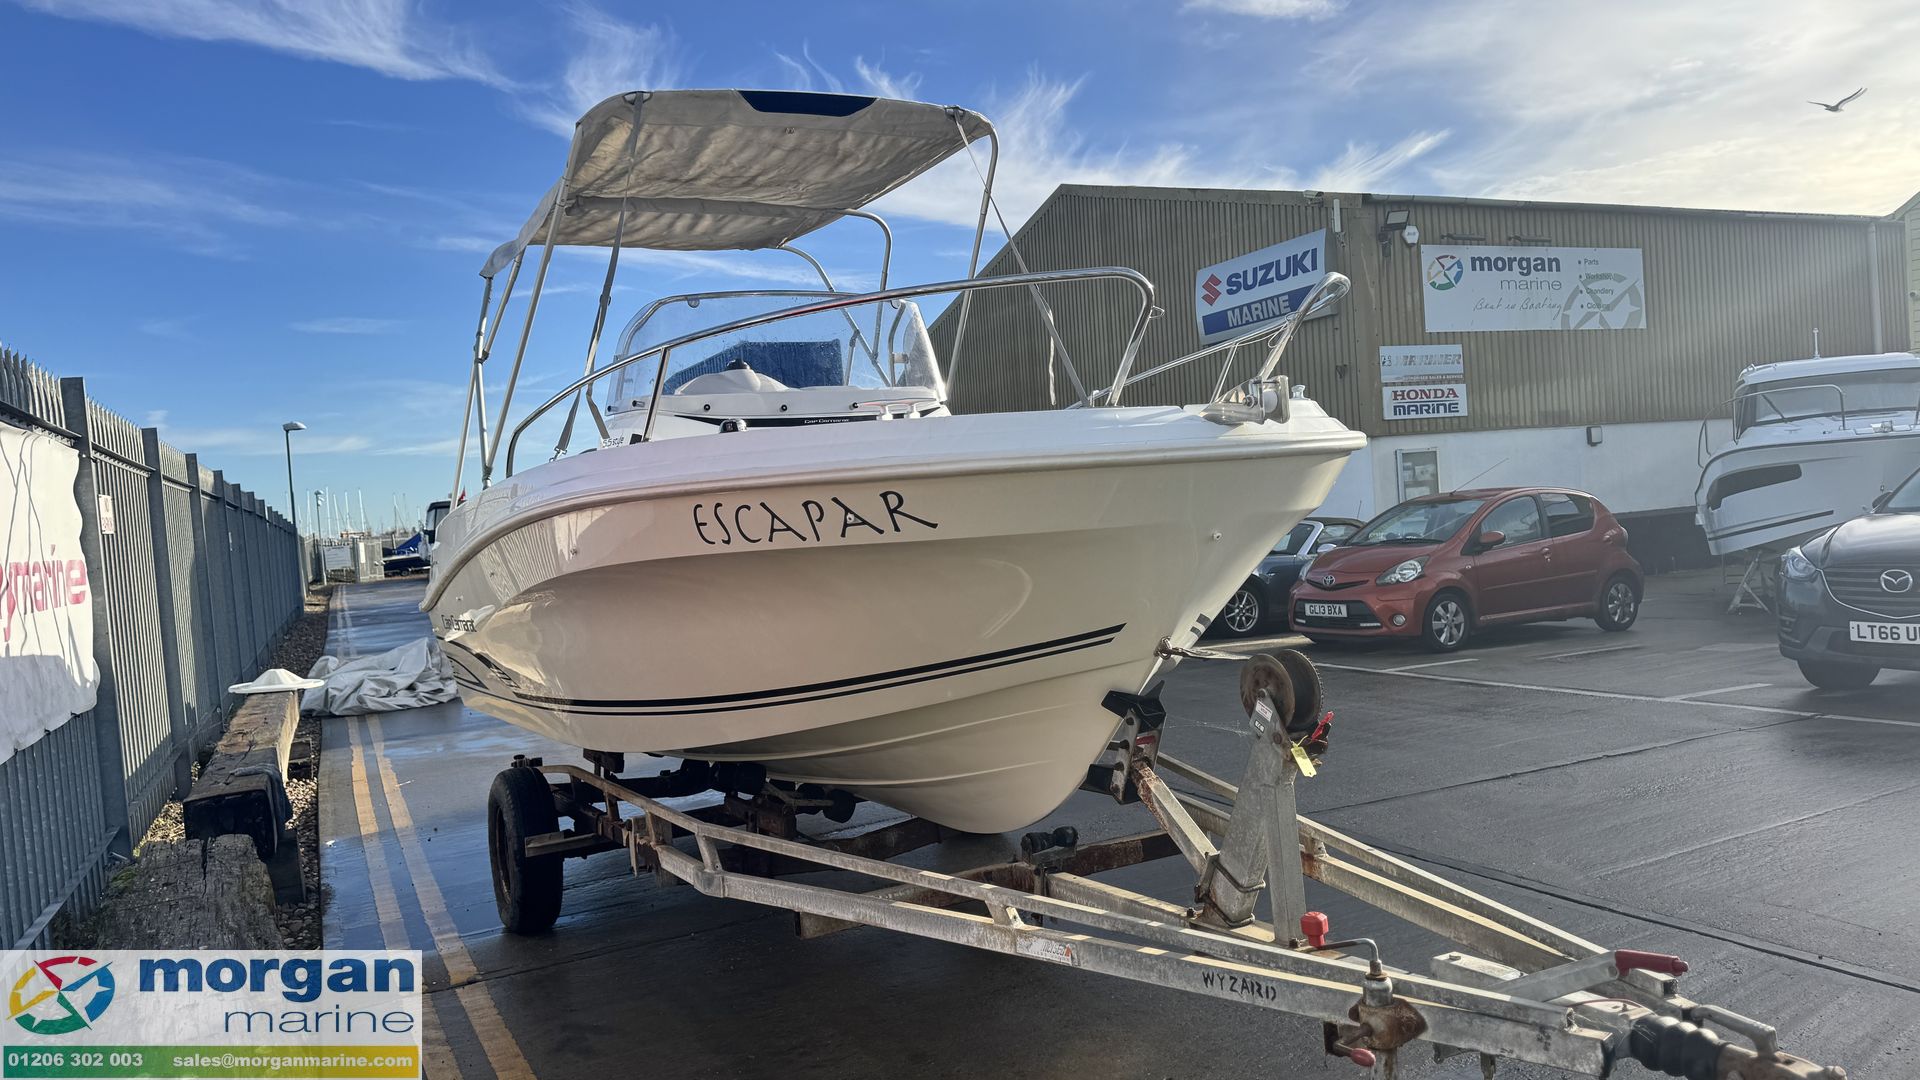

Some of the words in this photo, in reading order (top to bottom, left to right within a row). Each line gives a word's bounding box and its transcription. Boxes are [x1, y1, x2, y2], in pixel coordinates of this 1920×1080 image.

[1470, 255, 1561, 277] morgan
[1584, 258, 1600, 266] Parts
[1225, 247, 1318, 296] SUZUKI
[1500, 277, 1562, 291] marine
[1226, 294, 1292, 328] MARINE
[1391, 387, 1459, 401] HONDA
[1393, 402, 1460, 416] MARINE
[693, 490, 939, 545] ESCAPAR
[1309, 604, 1326, 615] GL13
[1327, 605, 1343, 616] BXA
[1856, 624, 1901, 641] LT66
[1905, 626, 1920, 642] U
[1202, 970, 1277, 1002] WYZARD
